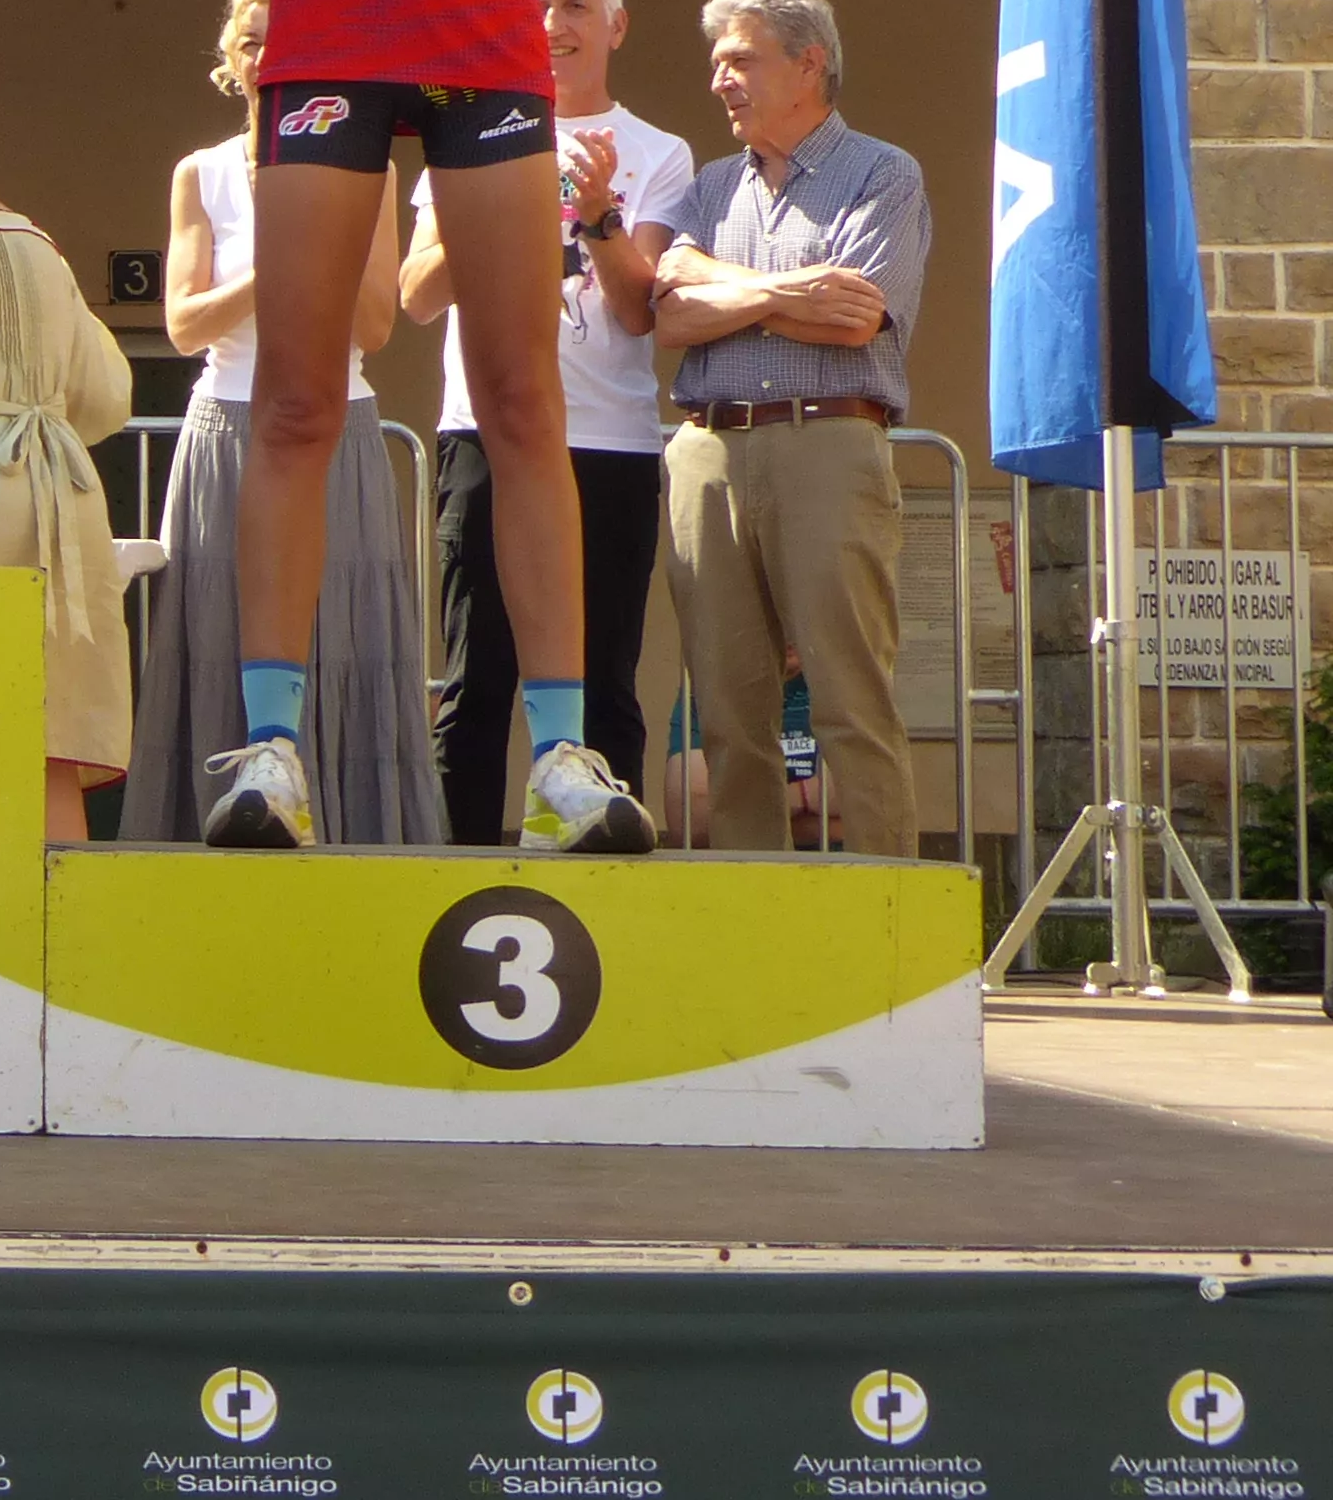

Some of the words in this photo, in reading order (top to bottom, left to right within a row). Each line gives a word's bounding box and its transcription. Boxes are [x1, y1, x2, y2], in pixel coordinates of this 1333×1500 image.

[478, 118, 541, 140] MERCURY
[124, 260, 149, 296] 3
[1148, 559, 1217, 585] POHIBIDO
[1264, 561, 1282, 586] AL
[1177, 594, 1186, 618] Y
[1188, 594, 1249, 619] ARROAR
[1250, 594, 1304, 620] BASUR
[1184, 638, 1213, 656] BAJO
[459, 914, 561, 1042] 3
[143, 1451, 332, 1473] Ayuntamiento
[469, 1453, 657, 1475] Ayuntamiento
[793, 1454, 982, 1476] Ayuntamiento
[1110, 1454, 1299, 1477] Ayuntamiento
